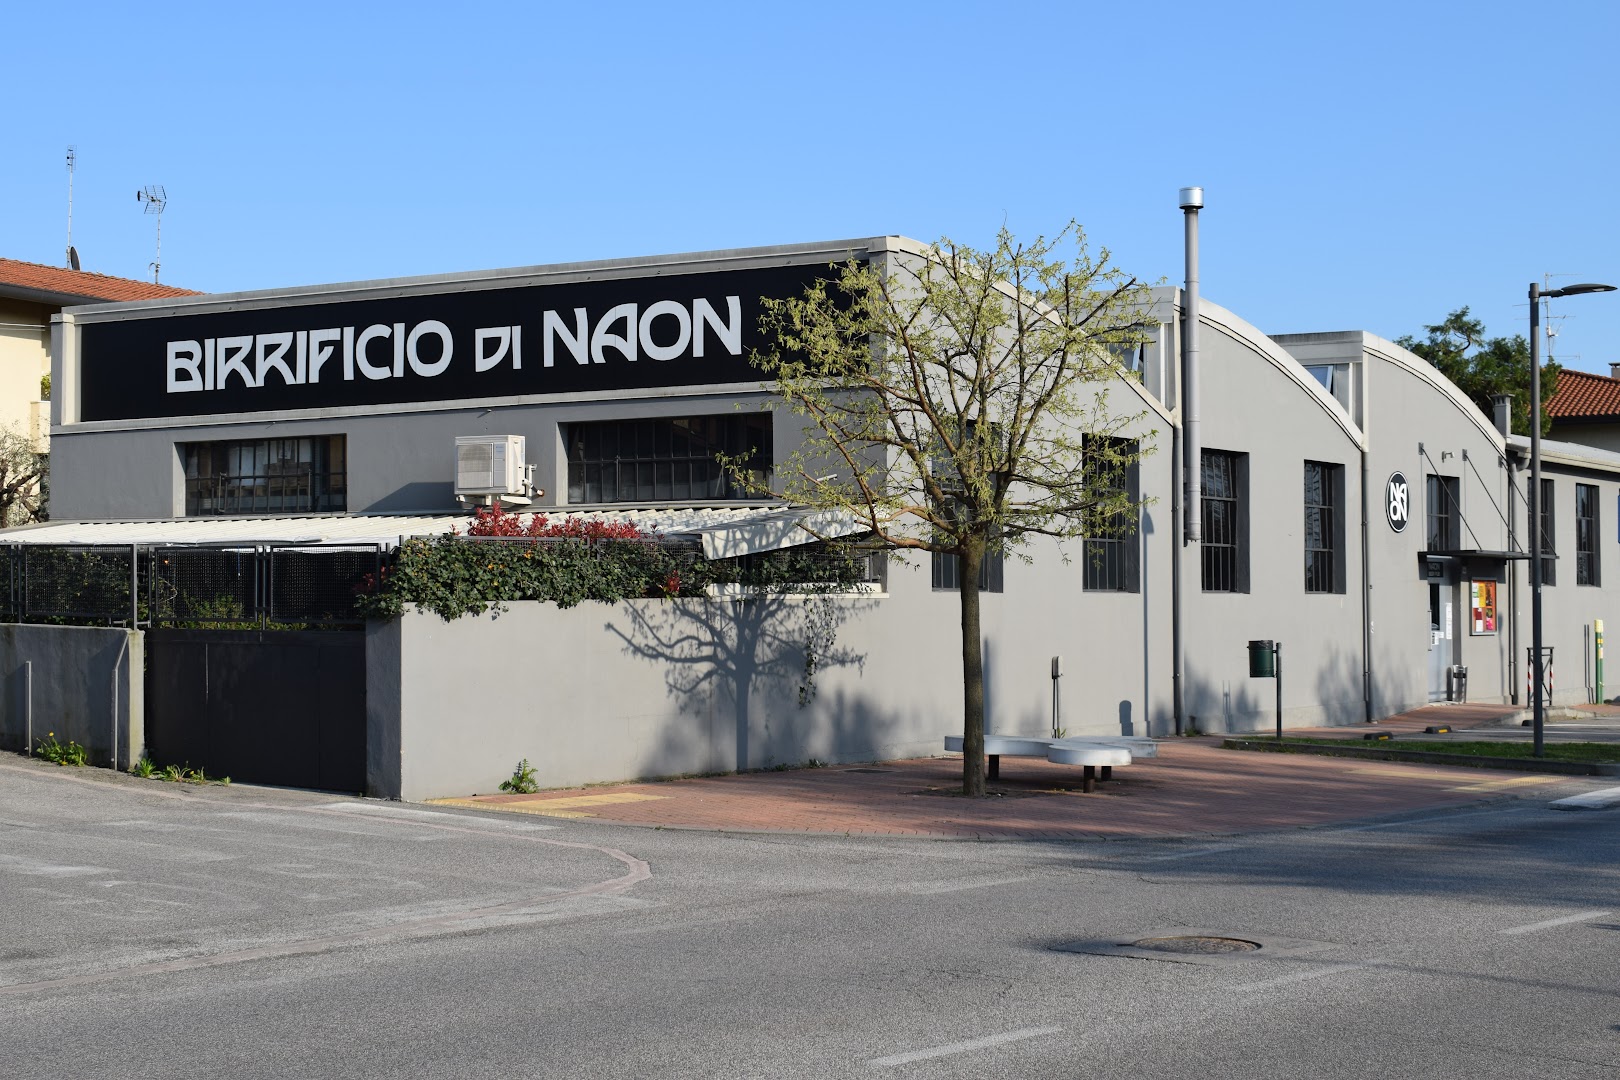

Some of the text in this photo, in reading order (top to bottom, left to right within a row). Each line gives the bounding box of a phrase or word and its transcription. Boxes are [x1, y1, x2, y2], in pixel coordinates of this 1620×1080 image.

[167, 296, 742, 394] BIRRIFICIO DI NAON
